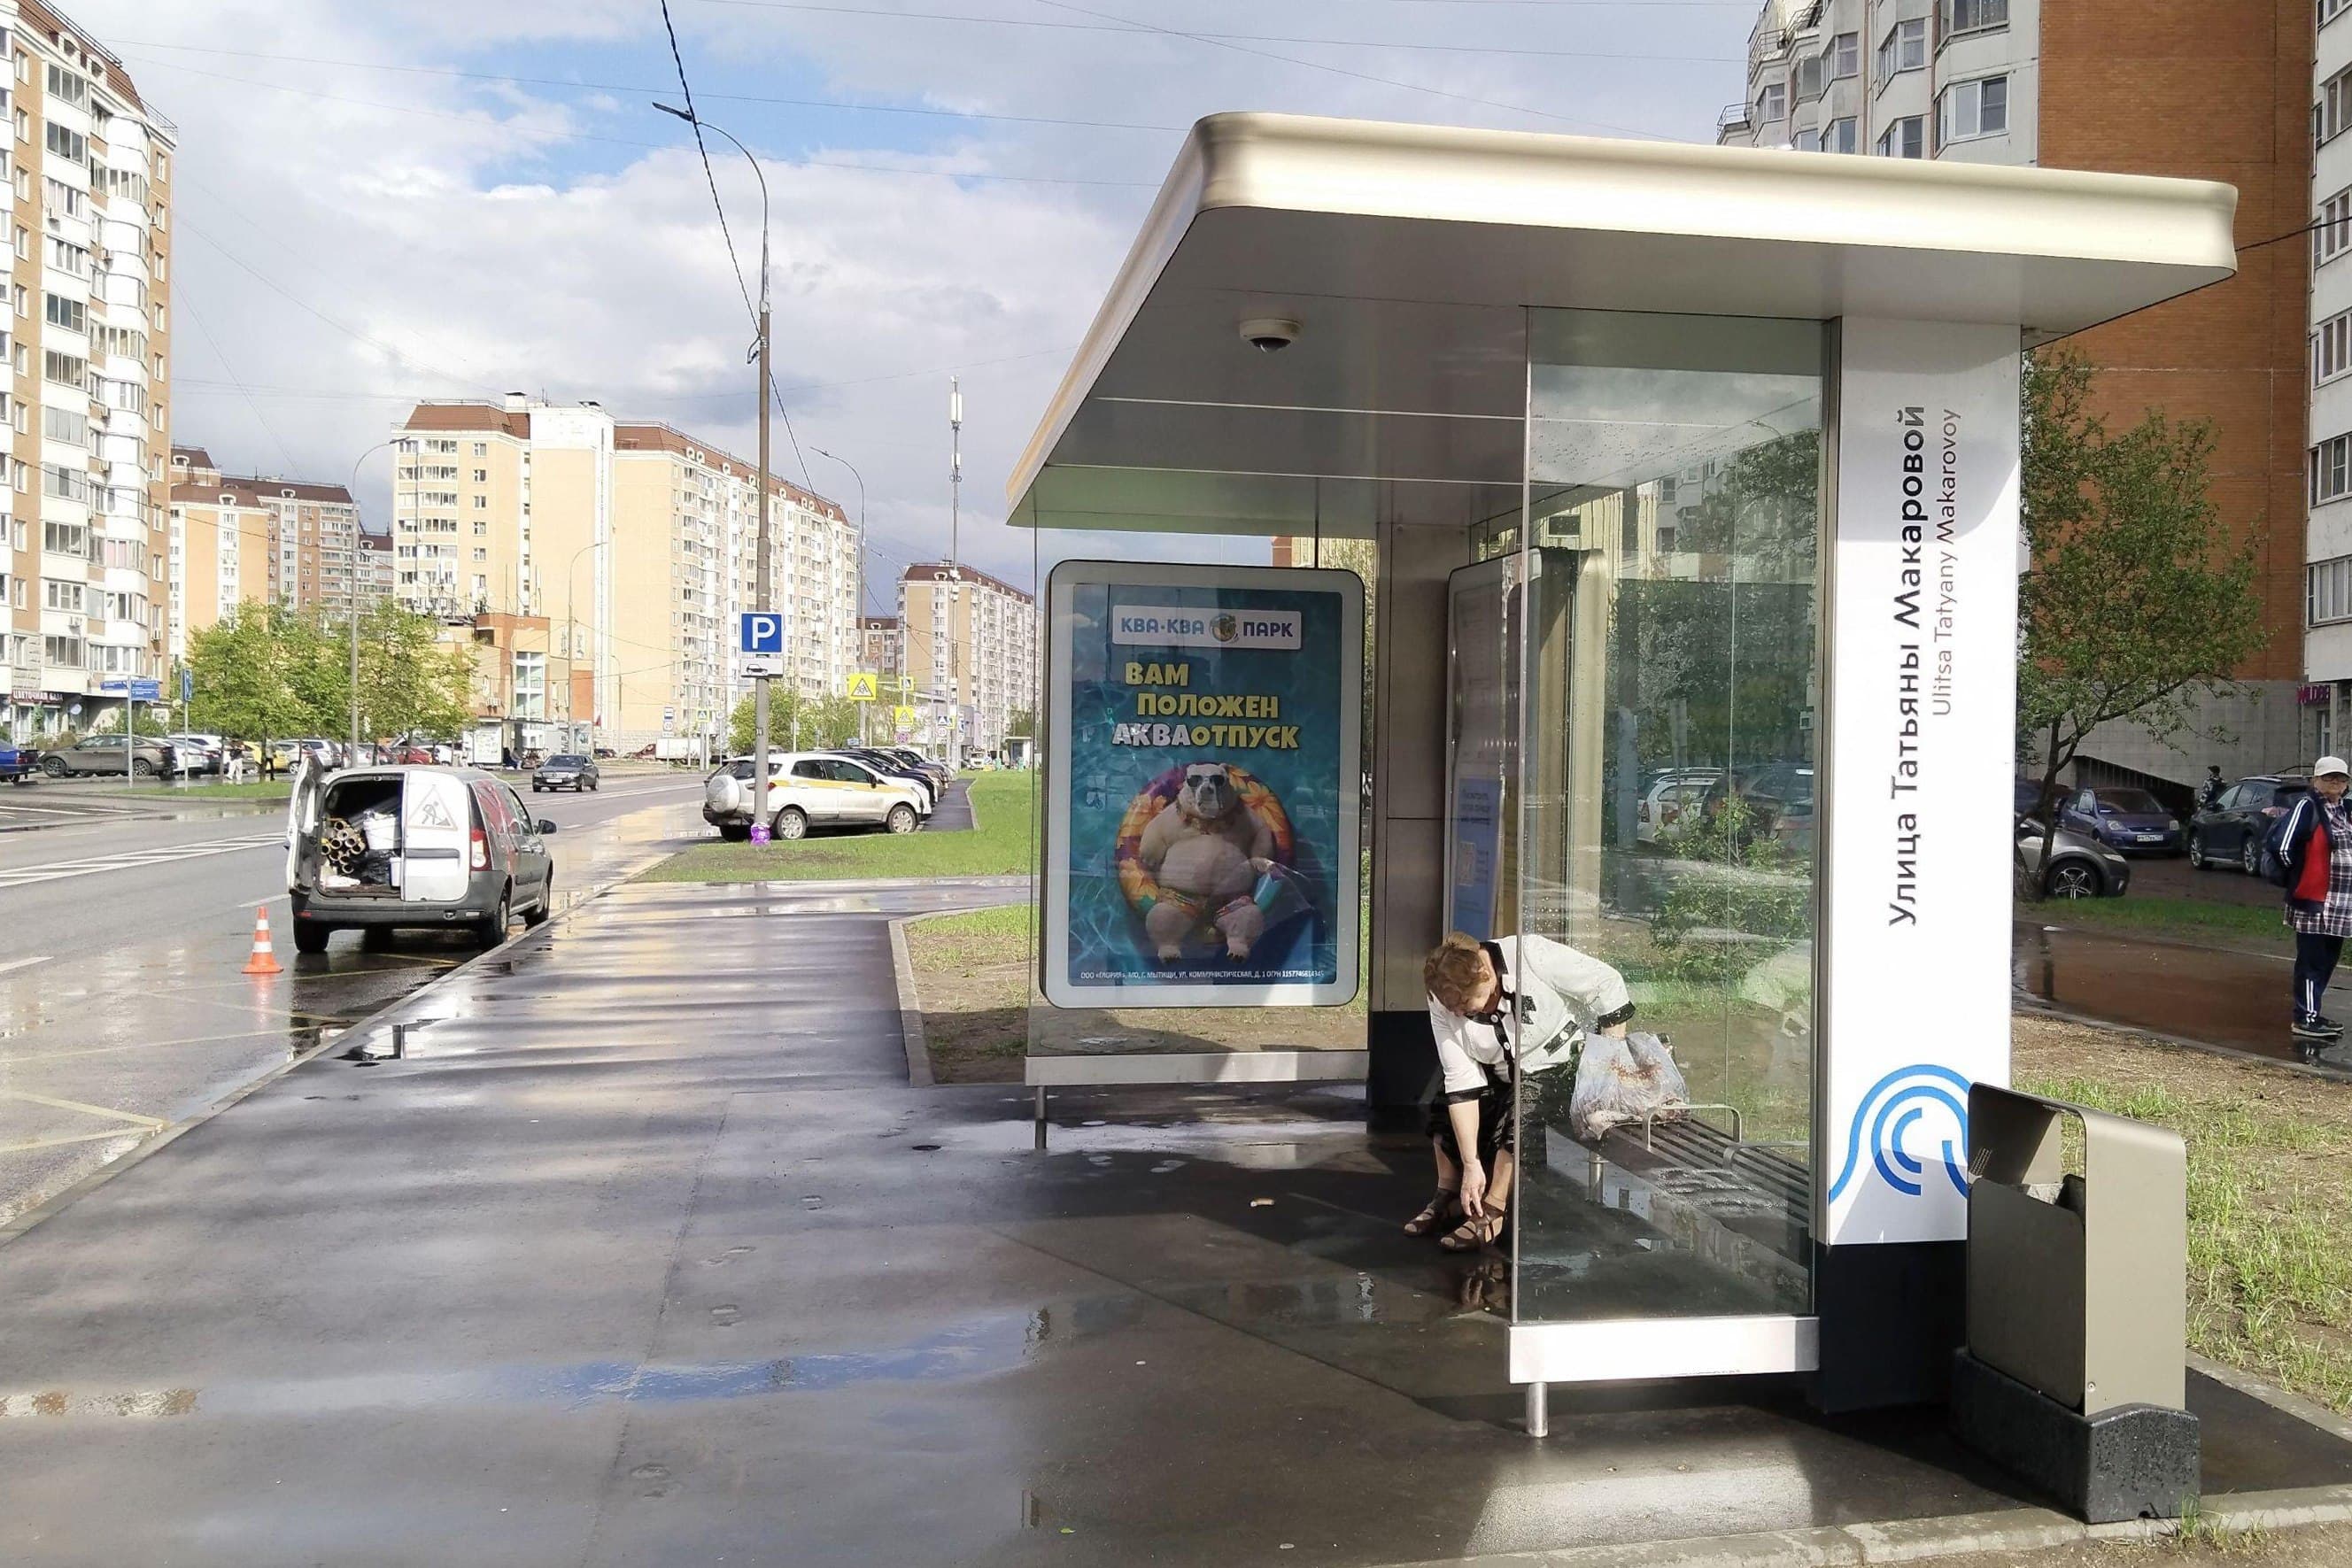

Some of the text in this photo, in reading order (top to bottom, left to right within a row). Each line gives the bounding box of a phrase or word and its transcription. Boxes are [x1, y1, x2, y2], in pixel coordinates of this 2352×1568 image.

[1931, 408, 1961, 715] Ulitsa Tatyany Makarovoy
[752, 616, 776, 650] P
[1242, 622, 1294, 637] ПАРК
[1125, 661, 1189, 687] ВАМ
[1888, 406, 1929, 927] Улица Татьяны Макаровой
[1137, 692, 1279, 719] ПОЛОЖЕН
[1111, 722, 1300, 749] АКВАОТПУСК
